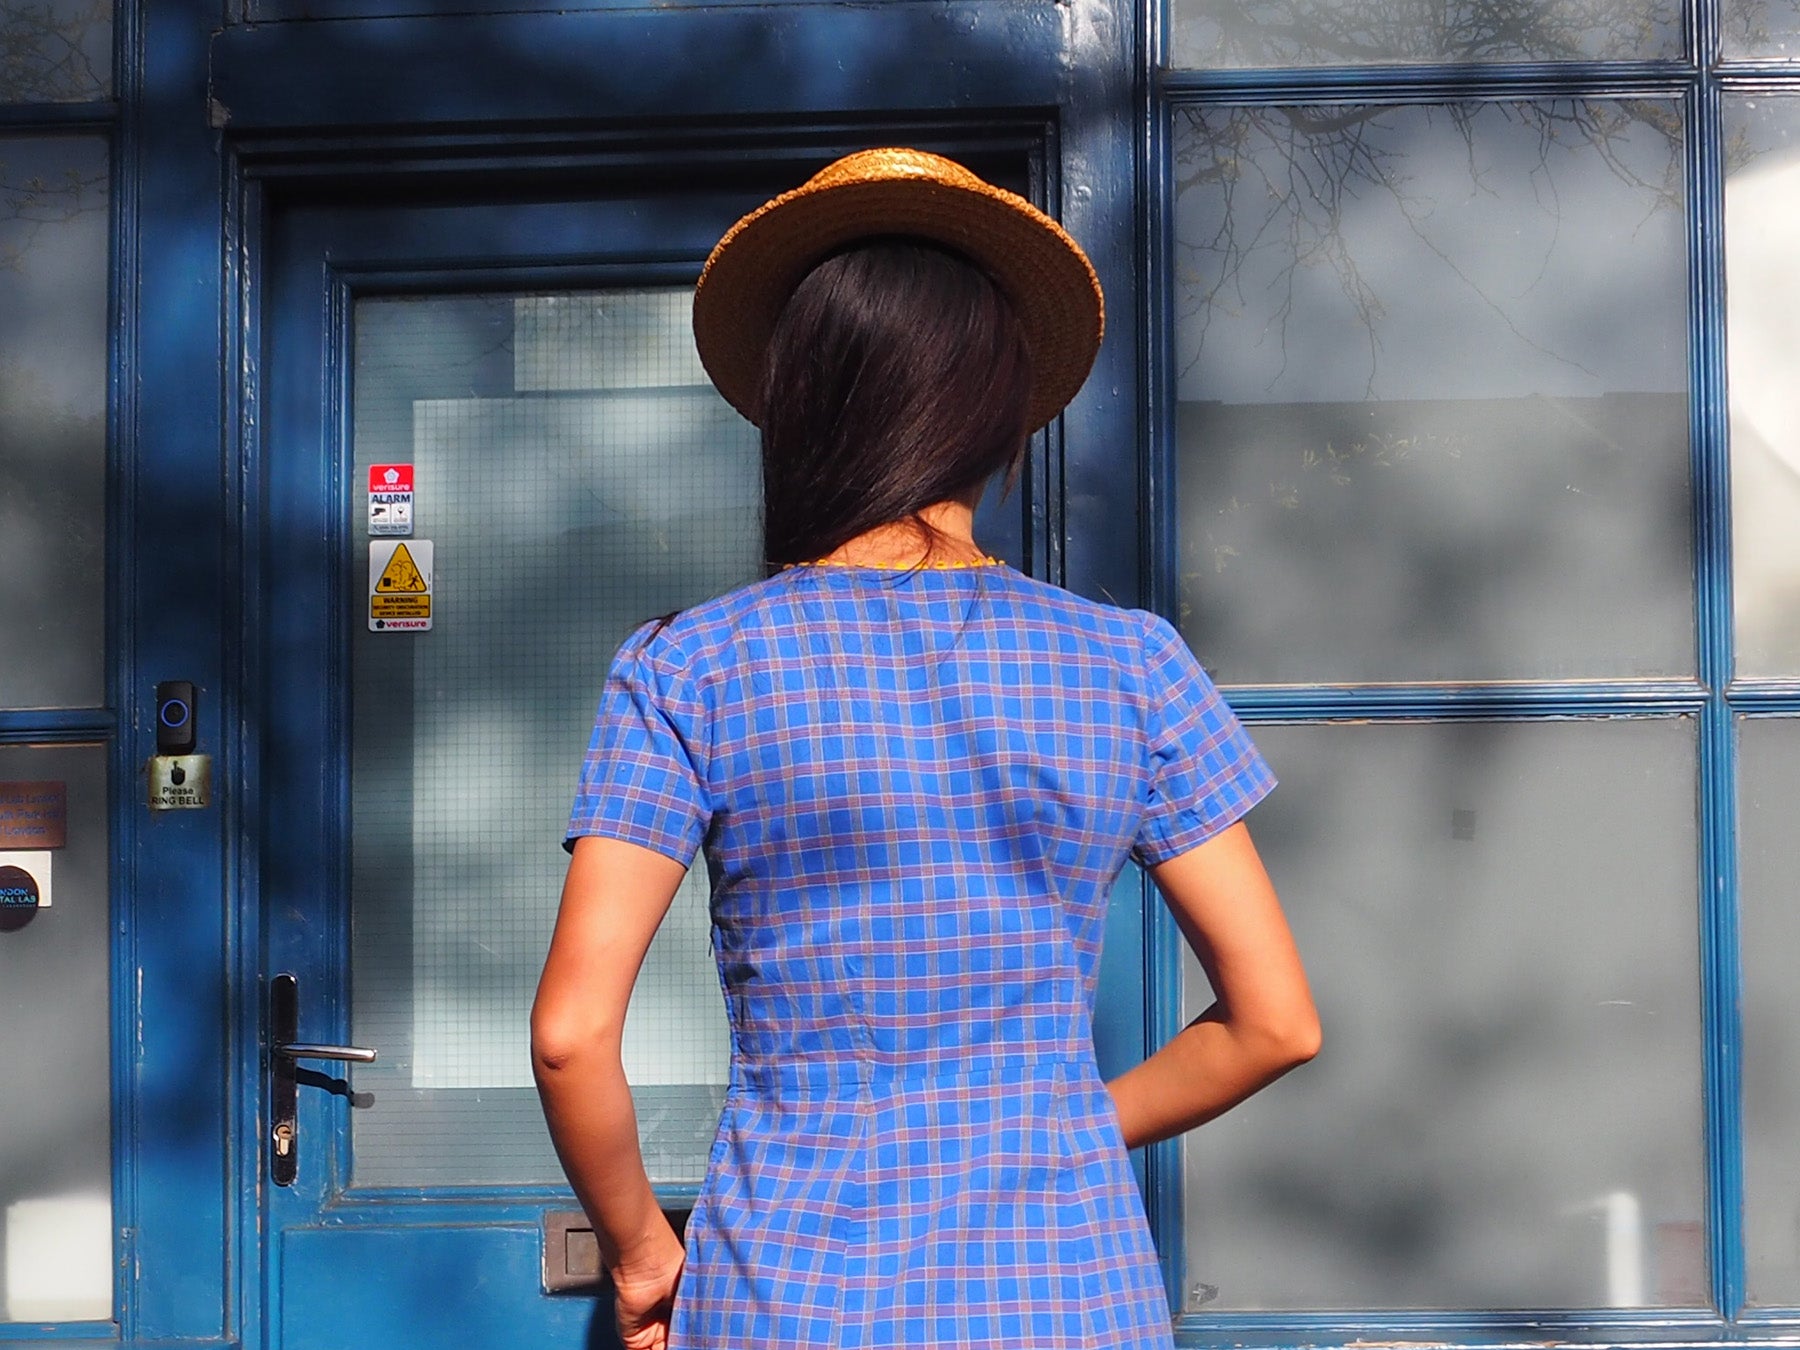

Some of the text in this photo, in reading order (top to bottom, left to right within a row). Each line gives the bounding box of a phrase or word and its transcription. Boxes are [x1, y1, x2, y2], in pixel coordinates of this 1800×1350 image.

[372, 494, 411, 503] ALARM
[386, 620, 427, 628] verisure
[162, 786, 194, 795] Please
[151, 796, 204, 805] RING BELL
[18, 895, 37, 904] LAB
